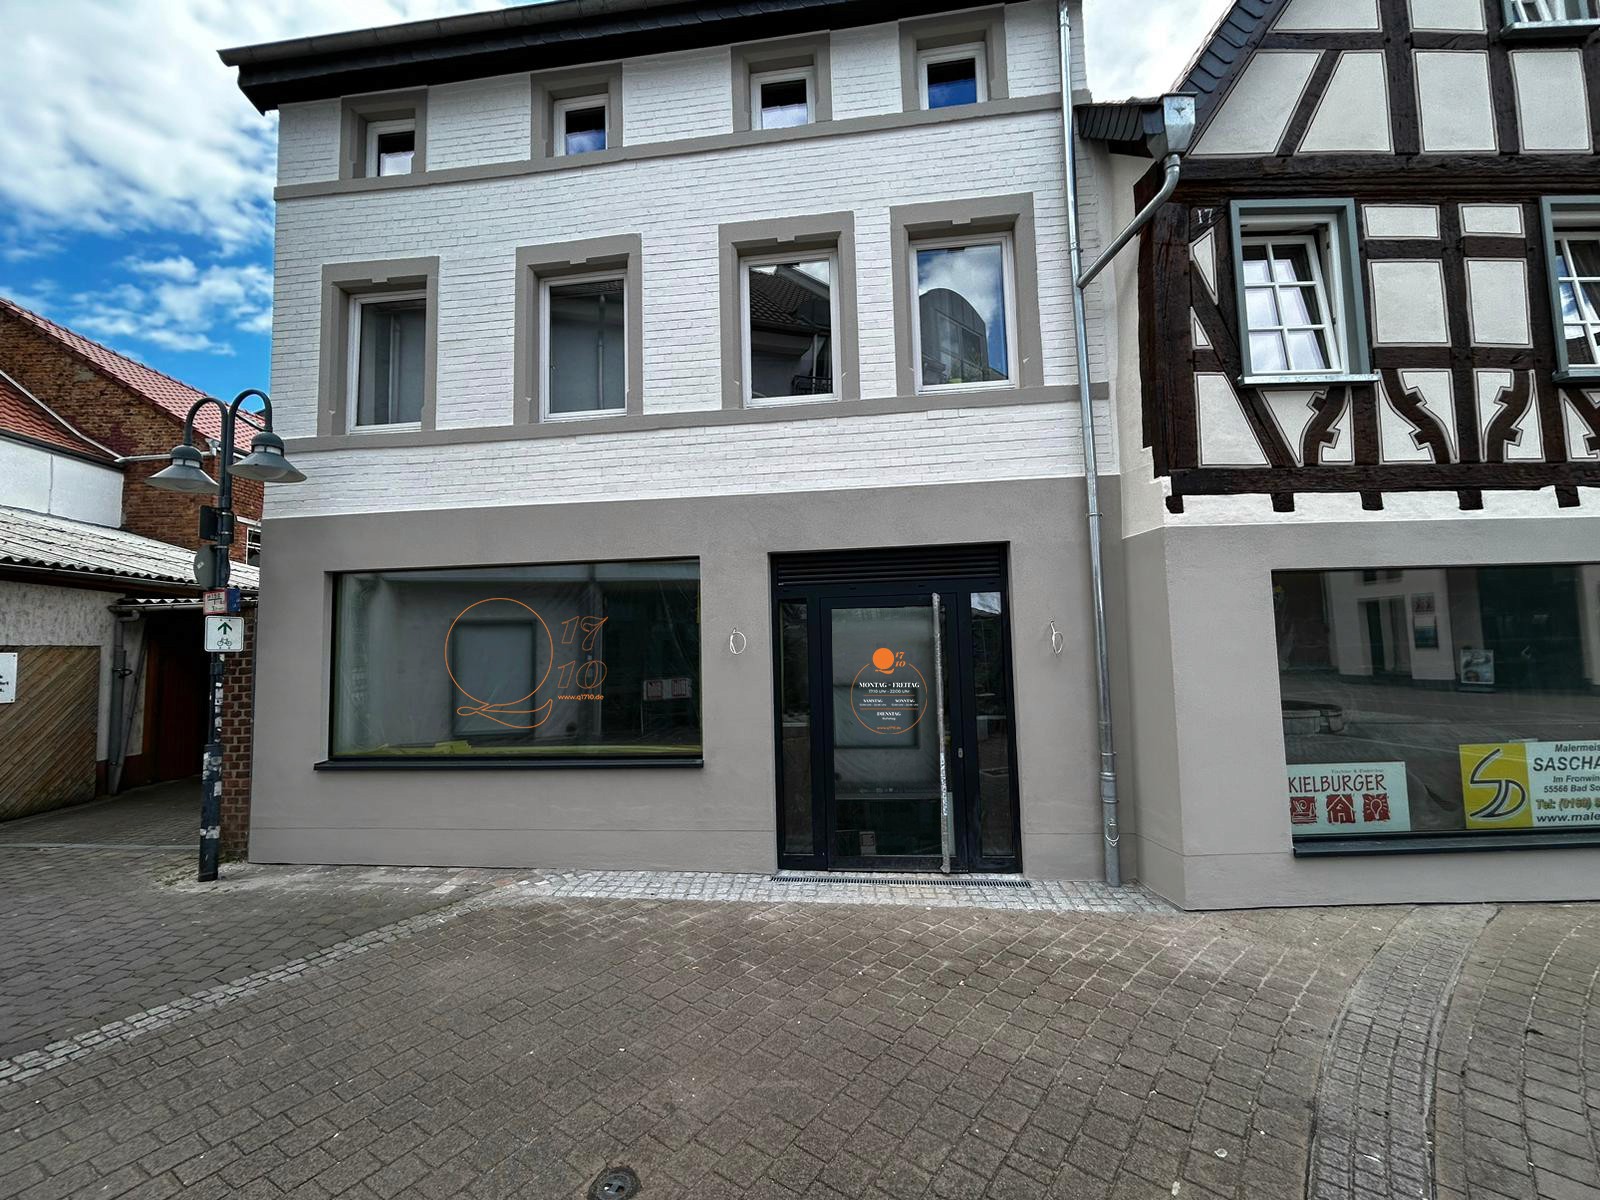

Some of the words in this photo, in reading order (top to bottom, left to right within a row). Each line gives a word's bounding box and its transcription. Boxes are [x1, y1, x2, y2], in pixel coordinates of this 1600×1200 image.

[561, 615, 608, 651] 17
[557, 660, 608, 689] 10
[557, 694, 605, 702] www.q1710.de
[1533, 755, 1600, 772] SASCHA
[1288, 774, 1387, 793] KIELBURGER
[1570, 784, 1587, 793] Bad
